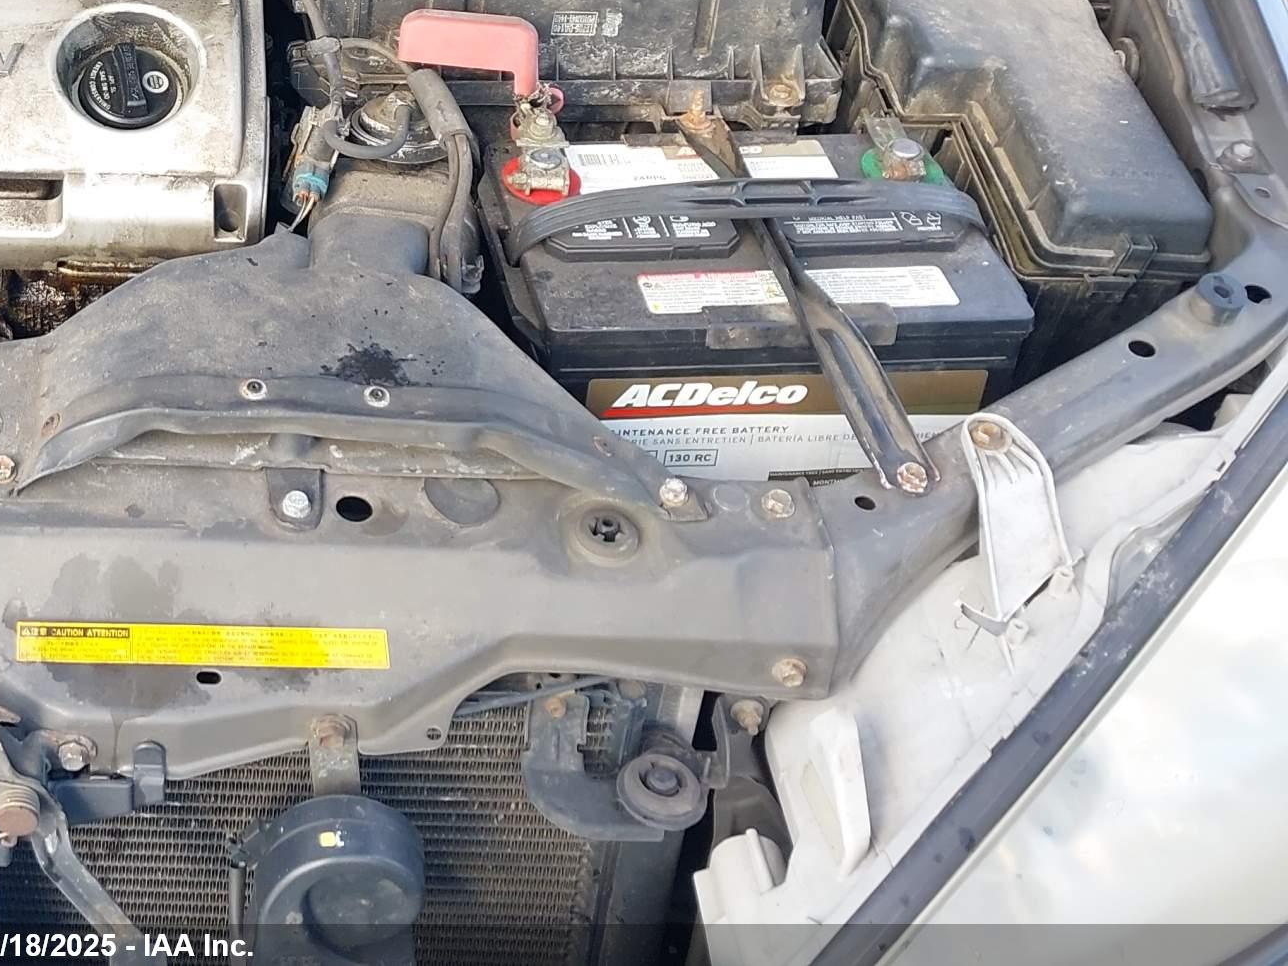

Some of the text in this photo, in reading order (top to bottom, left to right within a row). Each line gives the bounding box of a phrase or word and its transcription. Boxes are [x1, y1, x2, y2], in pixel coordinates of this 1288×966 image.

[612, 380, 809, 408] ACDelco
[613, 426, 789, 436] INTENANCE FREE BATTERY
[653, 436, 681, 445] SANS
[685, 436, 746, 445] ENTRETIEN
[668, 453, 712, 463] 130 RC
[51, 627, 84, 637] CAUTION
[86, 628, 129, 638] ATTENTION
